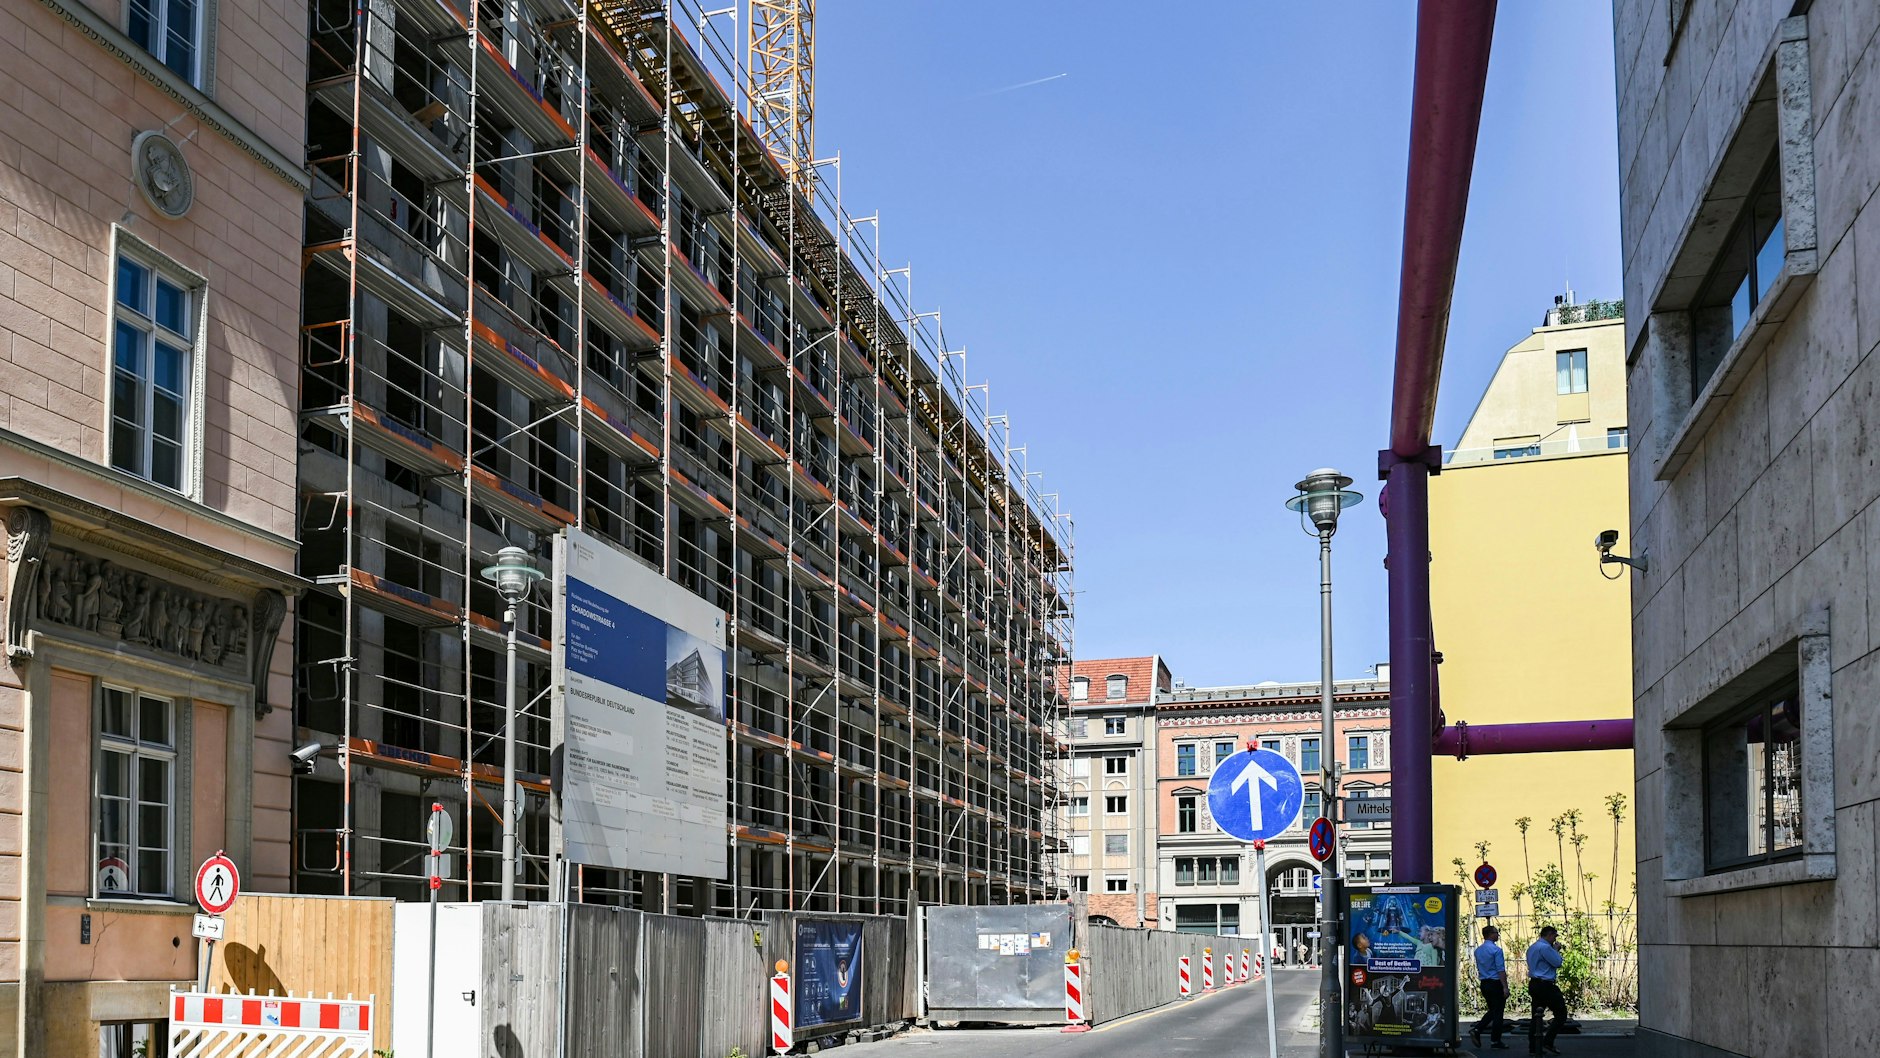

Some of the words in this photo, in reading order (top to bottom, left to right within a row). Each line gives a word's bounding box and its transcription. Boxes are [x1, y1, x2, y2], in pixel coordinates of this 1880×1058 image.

[571, 603, 611, 627] SCHADOWSTRASSE
[570, 687, 605, 705] BUNDESREPUBLIK
[607, 700, 635, 715] DEUTSCHLAND
[1357, 803, 1391, 814] Mittels
[1351, 900, 1361, 909] SEA
